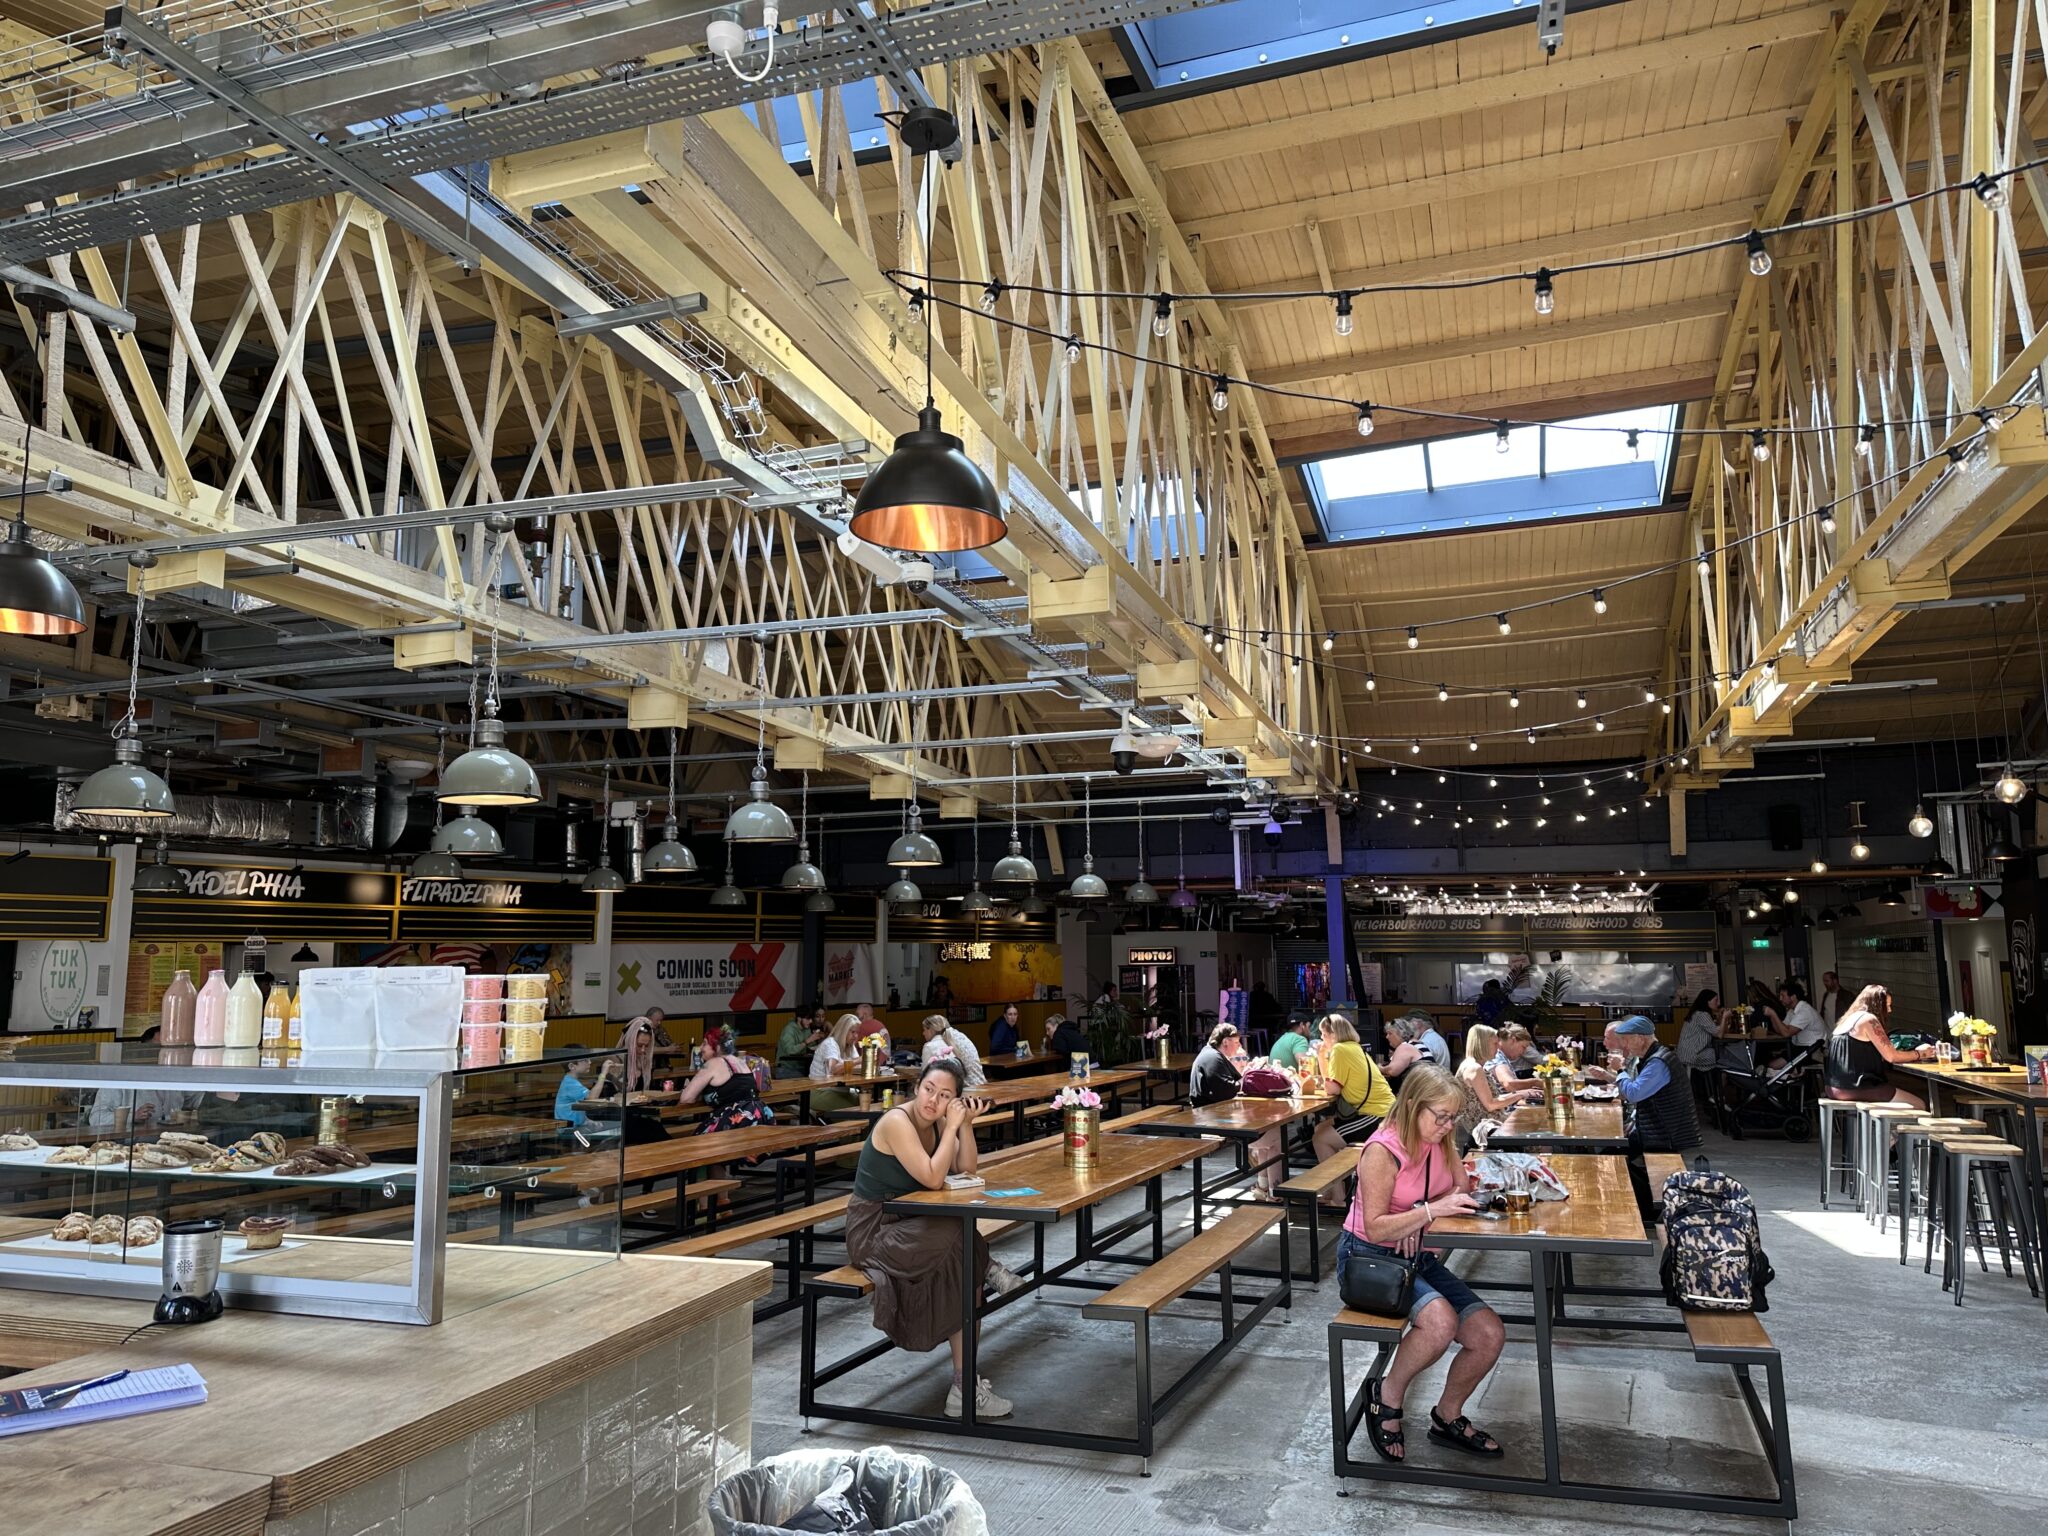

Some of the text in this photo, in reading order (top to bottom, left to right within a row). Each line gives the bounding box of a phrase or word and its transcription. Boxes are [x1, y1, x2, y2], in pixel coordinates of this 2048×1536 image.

[176, 868, 306, 899] PADELPHIA
[402, 879, 522, 905] FLIPADELPHIA
[1354, 918, 1481, 930] NEIGHBOURHOOD SUBS
[1531, 916, 1663, 929] NEIGHBOURHOOD SUBS
[52, 949, 79, 967] TUK
[1130, 951, 1173, 961] PHOTOS
[656, 959, 756, 979] COMING SOON
[50, 970, 77, 989] TUK
